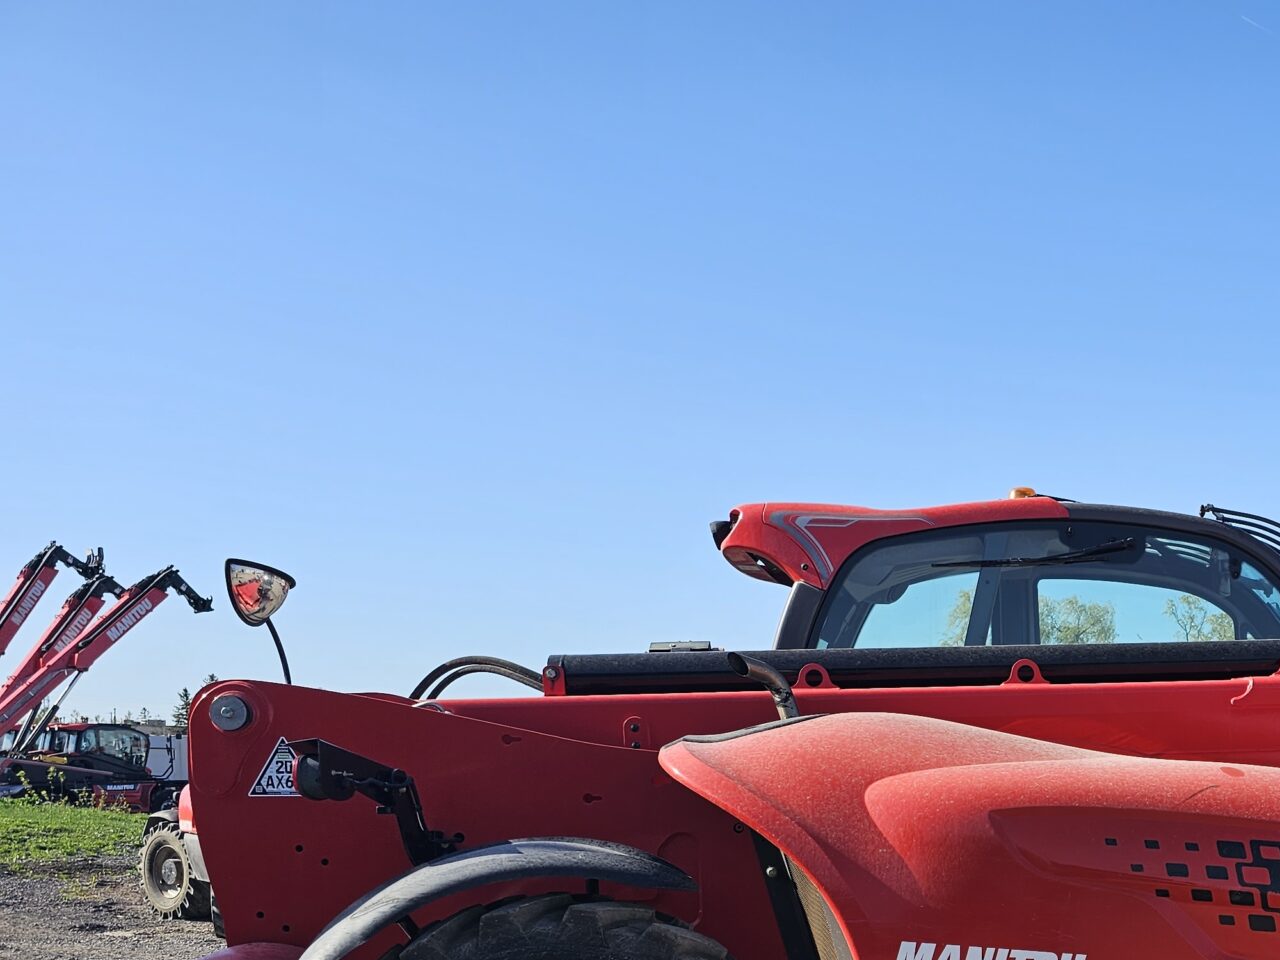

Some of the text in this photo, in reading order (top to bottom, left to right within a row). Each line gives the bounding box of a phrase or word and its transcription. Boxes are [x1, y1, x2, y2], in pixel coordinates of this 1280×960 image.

[11, 580, 46, 626] MANITOU
[106, 598, 153, 641] MANITOU
[54, 608, 93, 652] MANITOU
